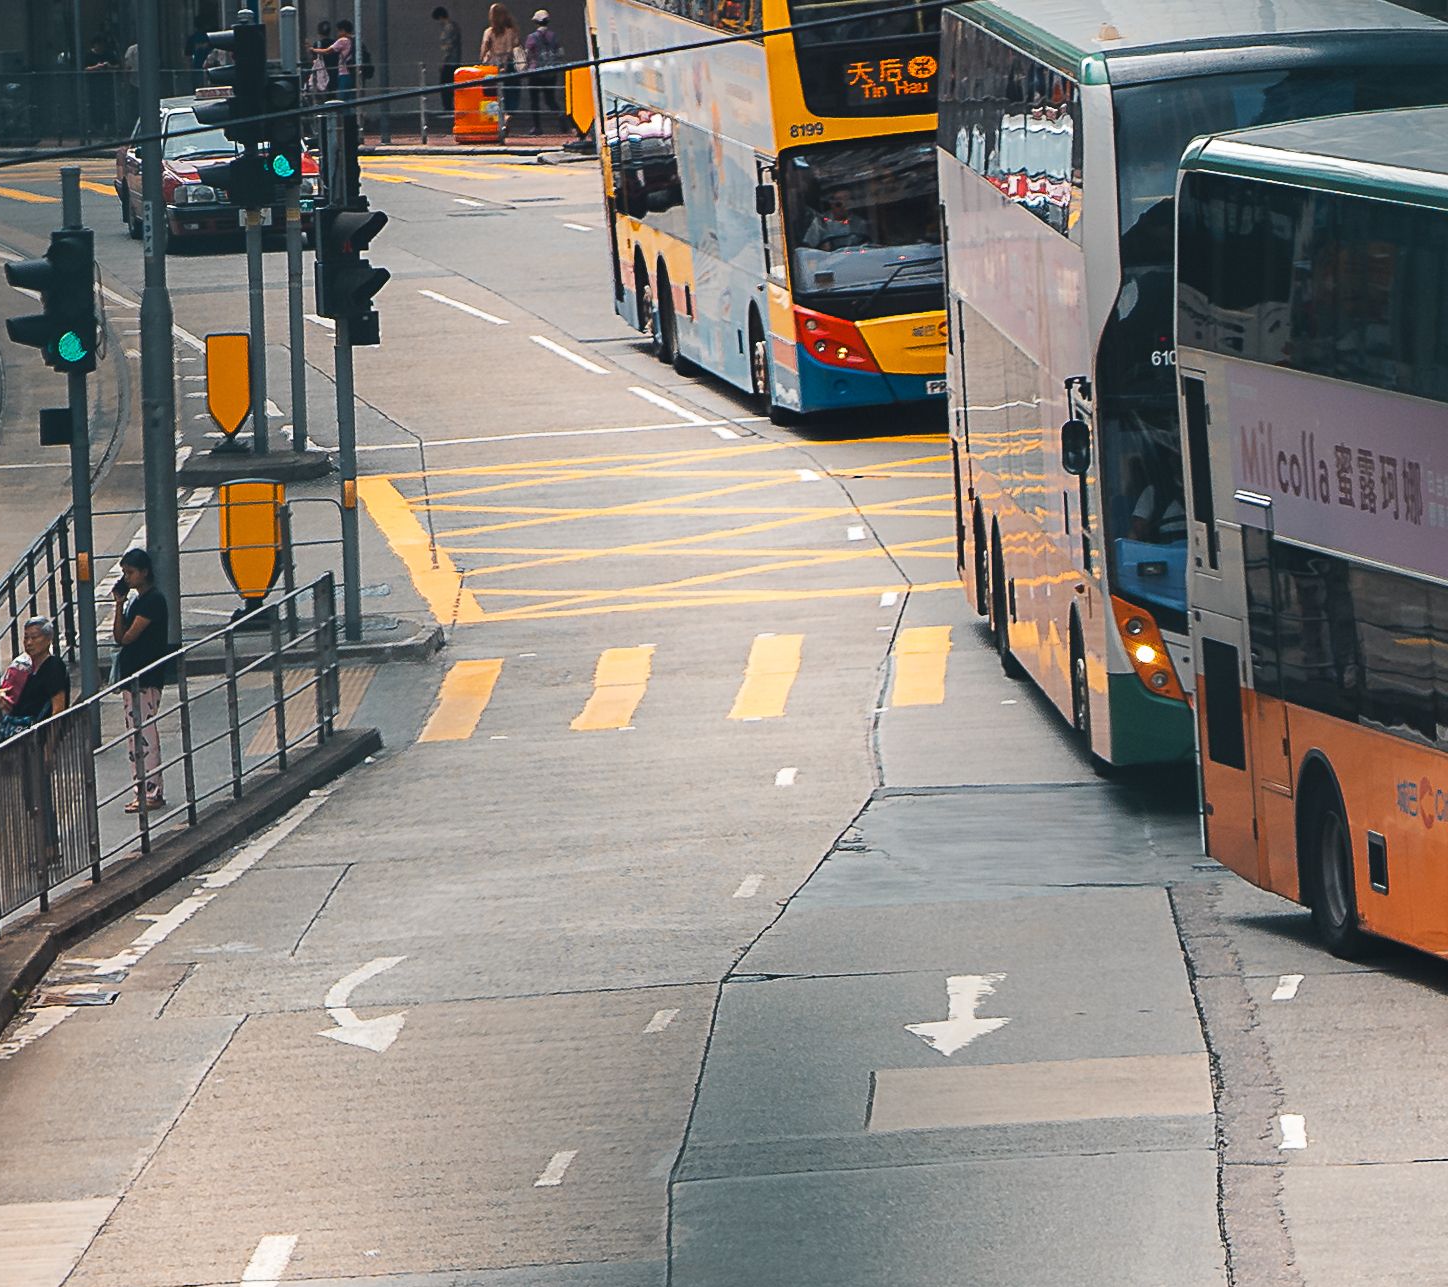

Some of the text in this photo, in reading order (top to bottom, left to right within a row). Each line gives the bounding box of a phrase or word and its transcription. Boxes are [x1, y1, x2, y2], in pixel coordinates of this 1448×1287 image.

[847, 59, 904, 86] 天后
[861, 80, 929, 98] Tin Hau
[790, 121, 824, 138] 8199
[1240, 420, 1424, 525] Milcolla 蜜露珂娜
